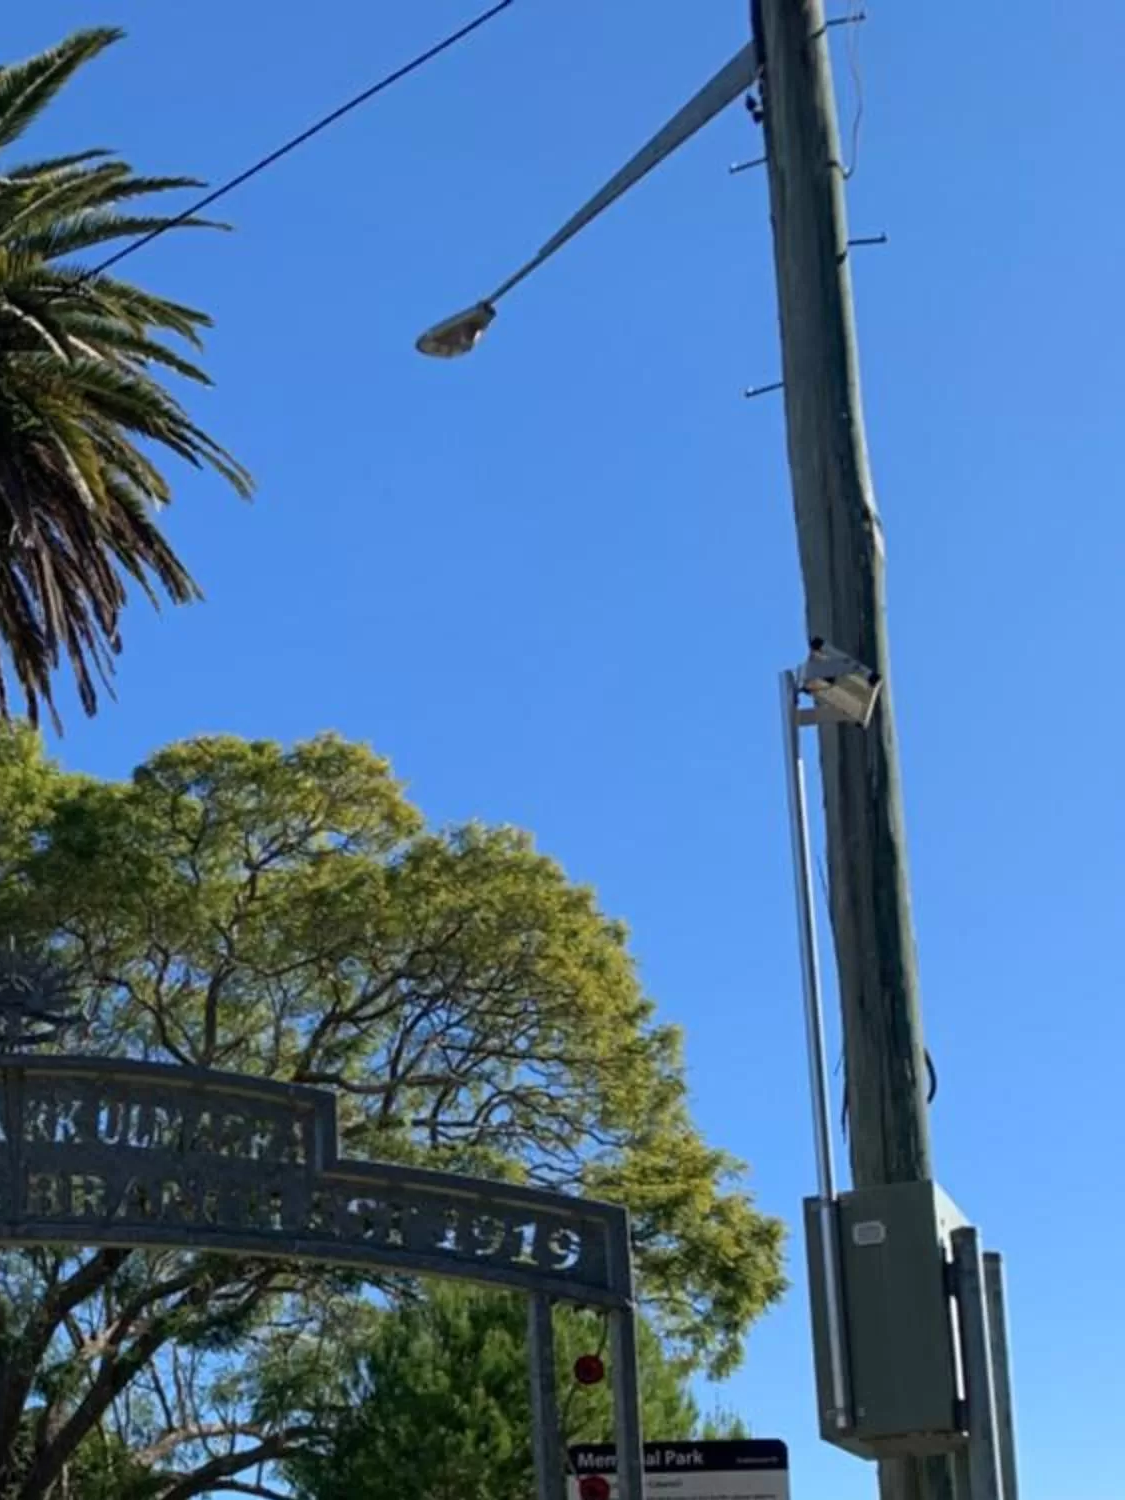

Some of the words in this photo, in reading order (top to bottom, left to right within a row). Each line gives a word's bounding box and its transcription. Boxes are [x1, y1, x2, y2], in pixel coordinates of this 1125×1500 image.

[433, 1207, 583, 1271] 1919
[577, 1449, 661, 1469] Memal
[664, 1447, 704, 1467] Park
